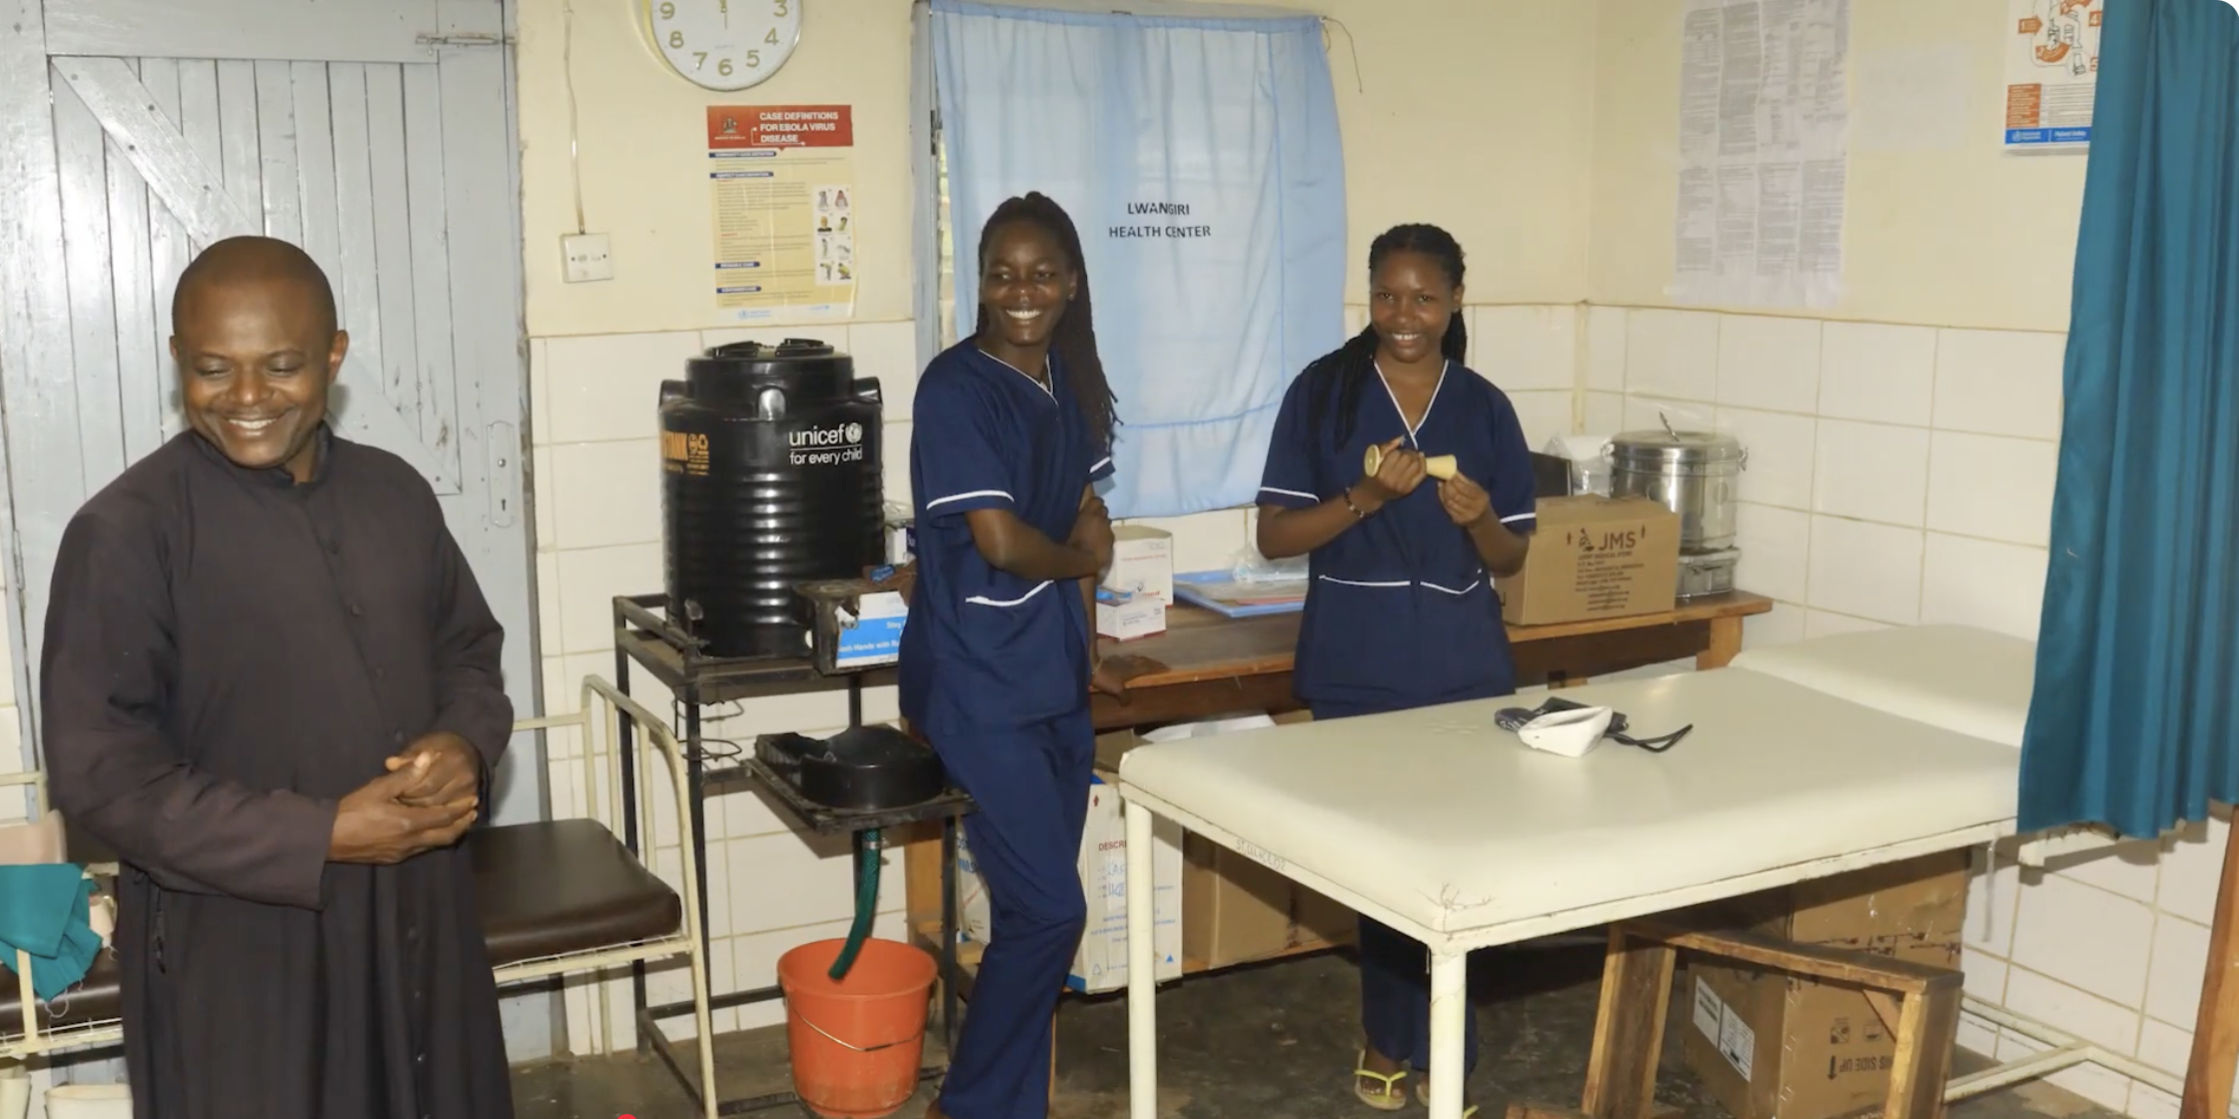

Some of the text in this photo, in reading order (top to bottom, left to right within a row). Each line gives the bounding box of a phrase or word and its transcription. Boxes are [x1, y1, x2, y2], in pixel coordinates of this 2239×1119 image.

[660, 1, 675, 20] 9
[773, 0, 788, 18] 3
[669, 30, 684, 49] 8
[764, 27, 779, 46] 4
[692, 52, 708, 70] 7
[717, 58, 733, 76] 6
[746, 50, 760, 68] 5
[760, 111, 839, 121] CASE DEFINITIONS
[760, 122, 836, 132] FOR EBOLA VIRUS
[760, 134, 798, 143] DISEASE
[1127, 202, 1190, 215] LWANGIRI
[1109, 225, 1211, 238] HEALTH CENTER
[789, 424, 844, 446] unicef
[790, 447, 863, 465] for every child
[1598, 531, 1637, 551] JMS
[1839, 1058, 1853, 1073] UP
[1854, 1056, 1877, 1071] SIDE
